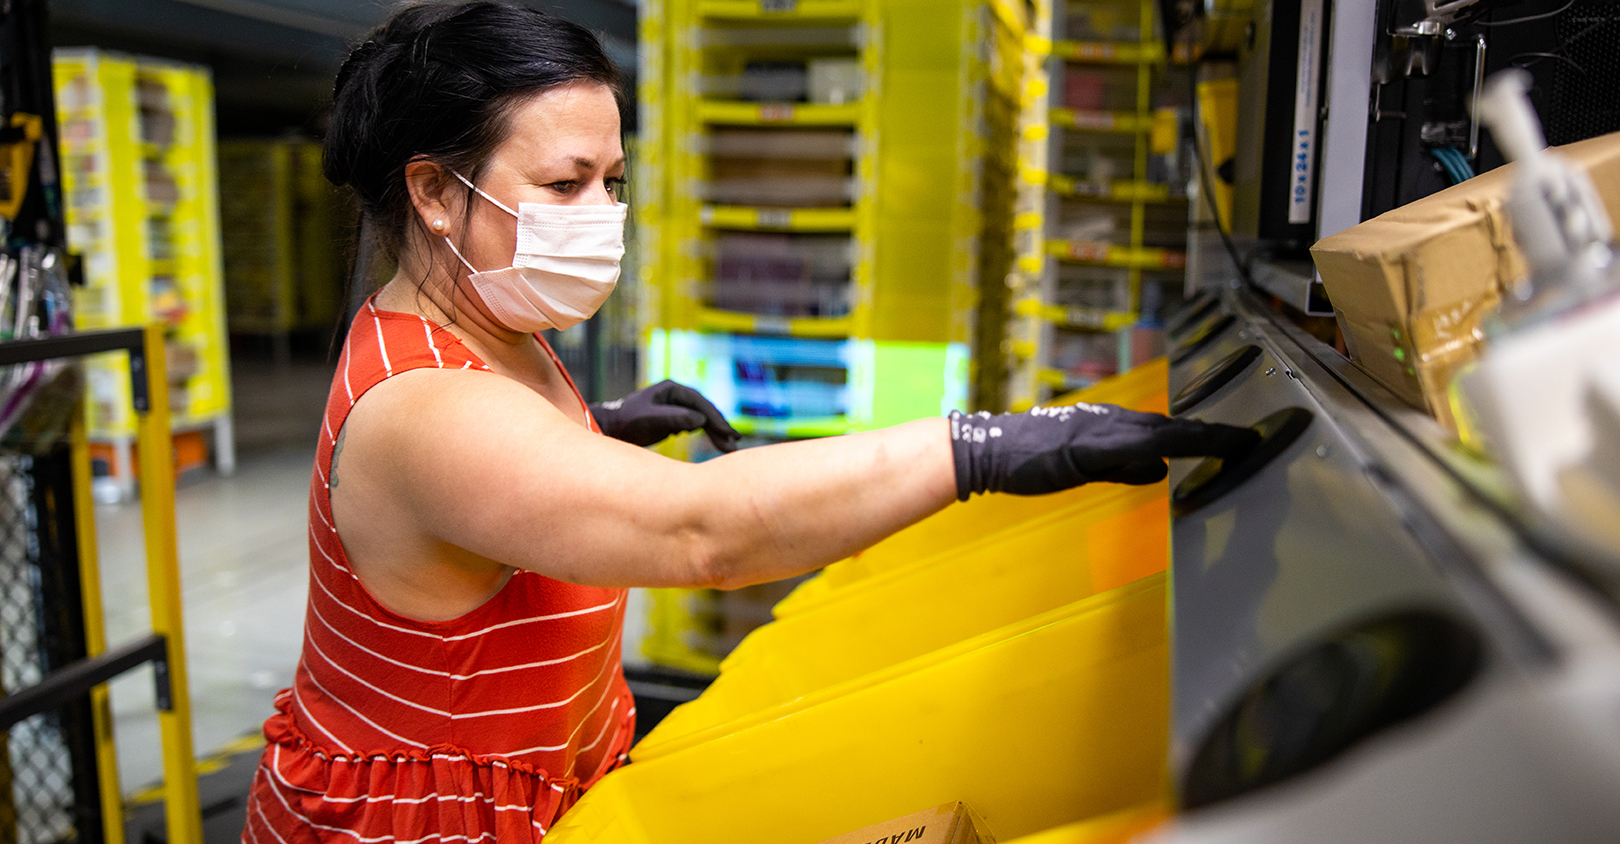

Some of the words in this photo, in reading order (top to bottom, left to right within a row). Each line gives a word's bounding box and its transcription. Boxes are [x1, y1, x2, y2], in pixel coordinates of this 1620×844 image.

[1295, 153, 1307, 172] 24
[1294, 185, 1306, 204] 10
[865, 825, 926, 844] MAD
